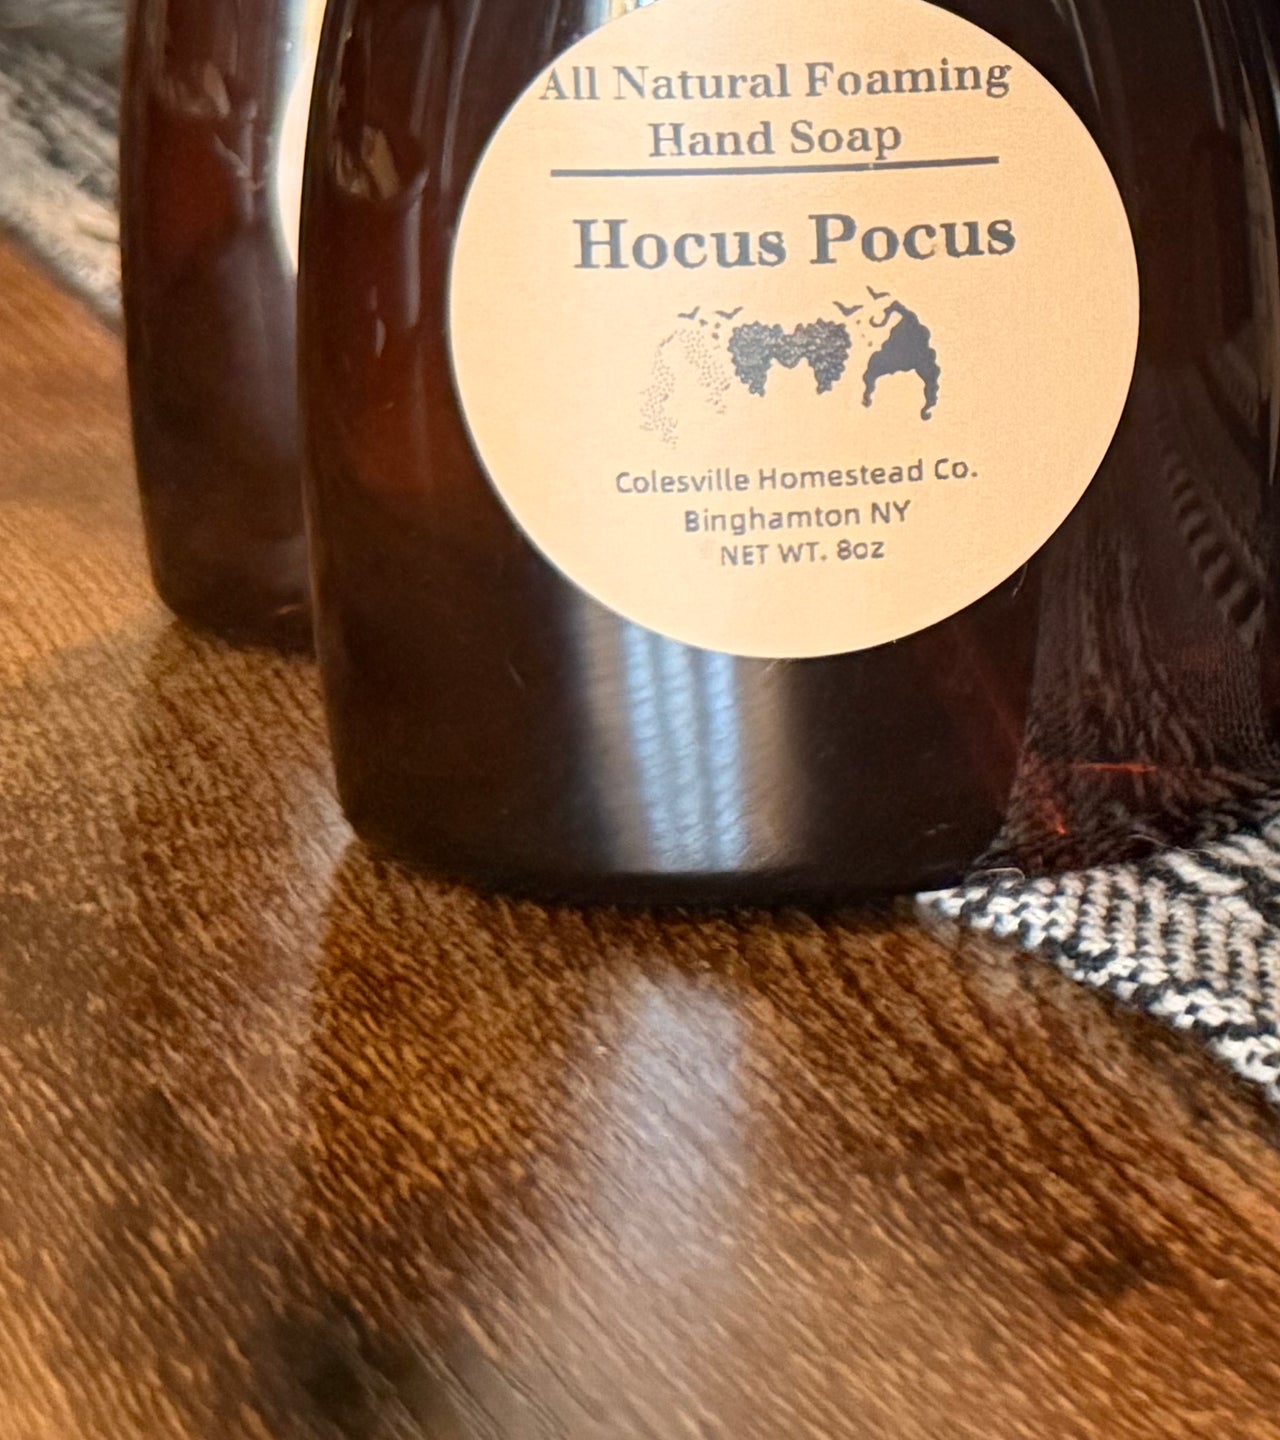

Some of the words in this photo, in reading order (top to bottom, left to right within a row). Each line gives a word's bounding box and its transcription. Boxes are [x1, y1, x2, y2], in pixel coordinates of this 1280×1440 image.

[540, 66, 599, 102] All
[612, 62, 790, 102] Natural
[804, 57, 1013, 98] Foaming
[648, 120, 774, 158] Hand
[790, 119, 902, 160] Soap
[572, 216, 786, 270] Hocus
[808, 212, 1017, 264] Pocus
[615, 467, 750, 494] Colesville
[758, 461, 924, 490] Homestead
[934, 458, 979, 482] Co.
[684, 503, 861, 536] Binghamton
[871, 500, 911, 525] NY
[720, 543, 769, 566] NET
[777, 542, 828, 564] WT.
[837, 539, 885, 560] 8oz
